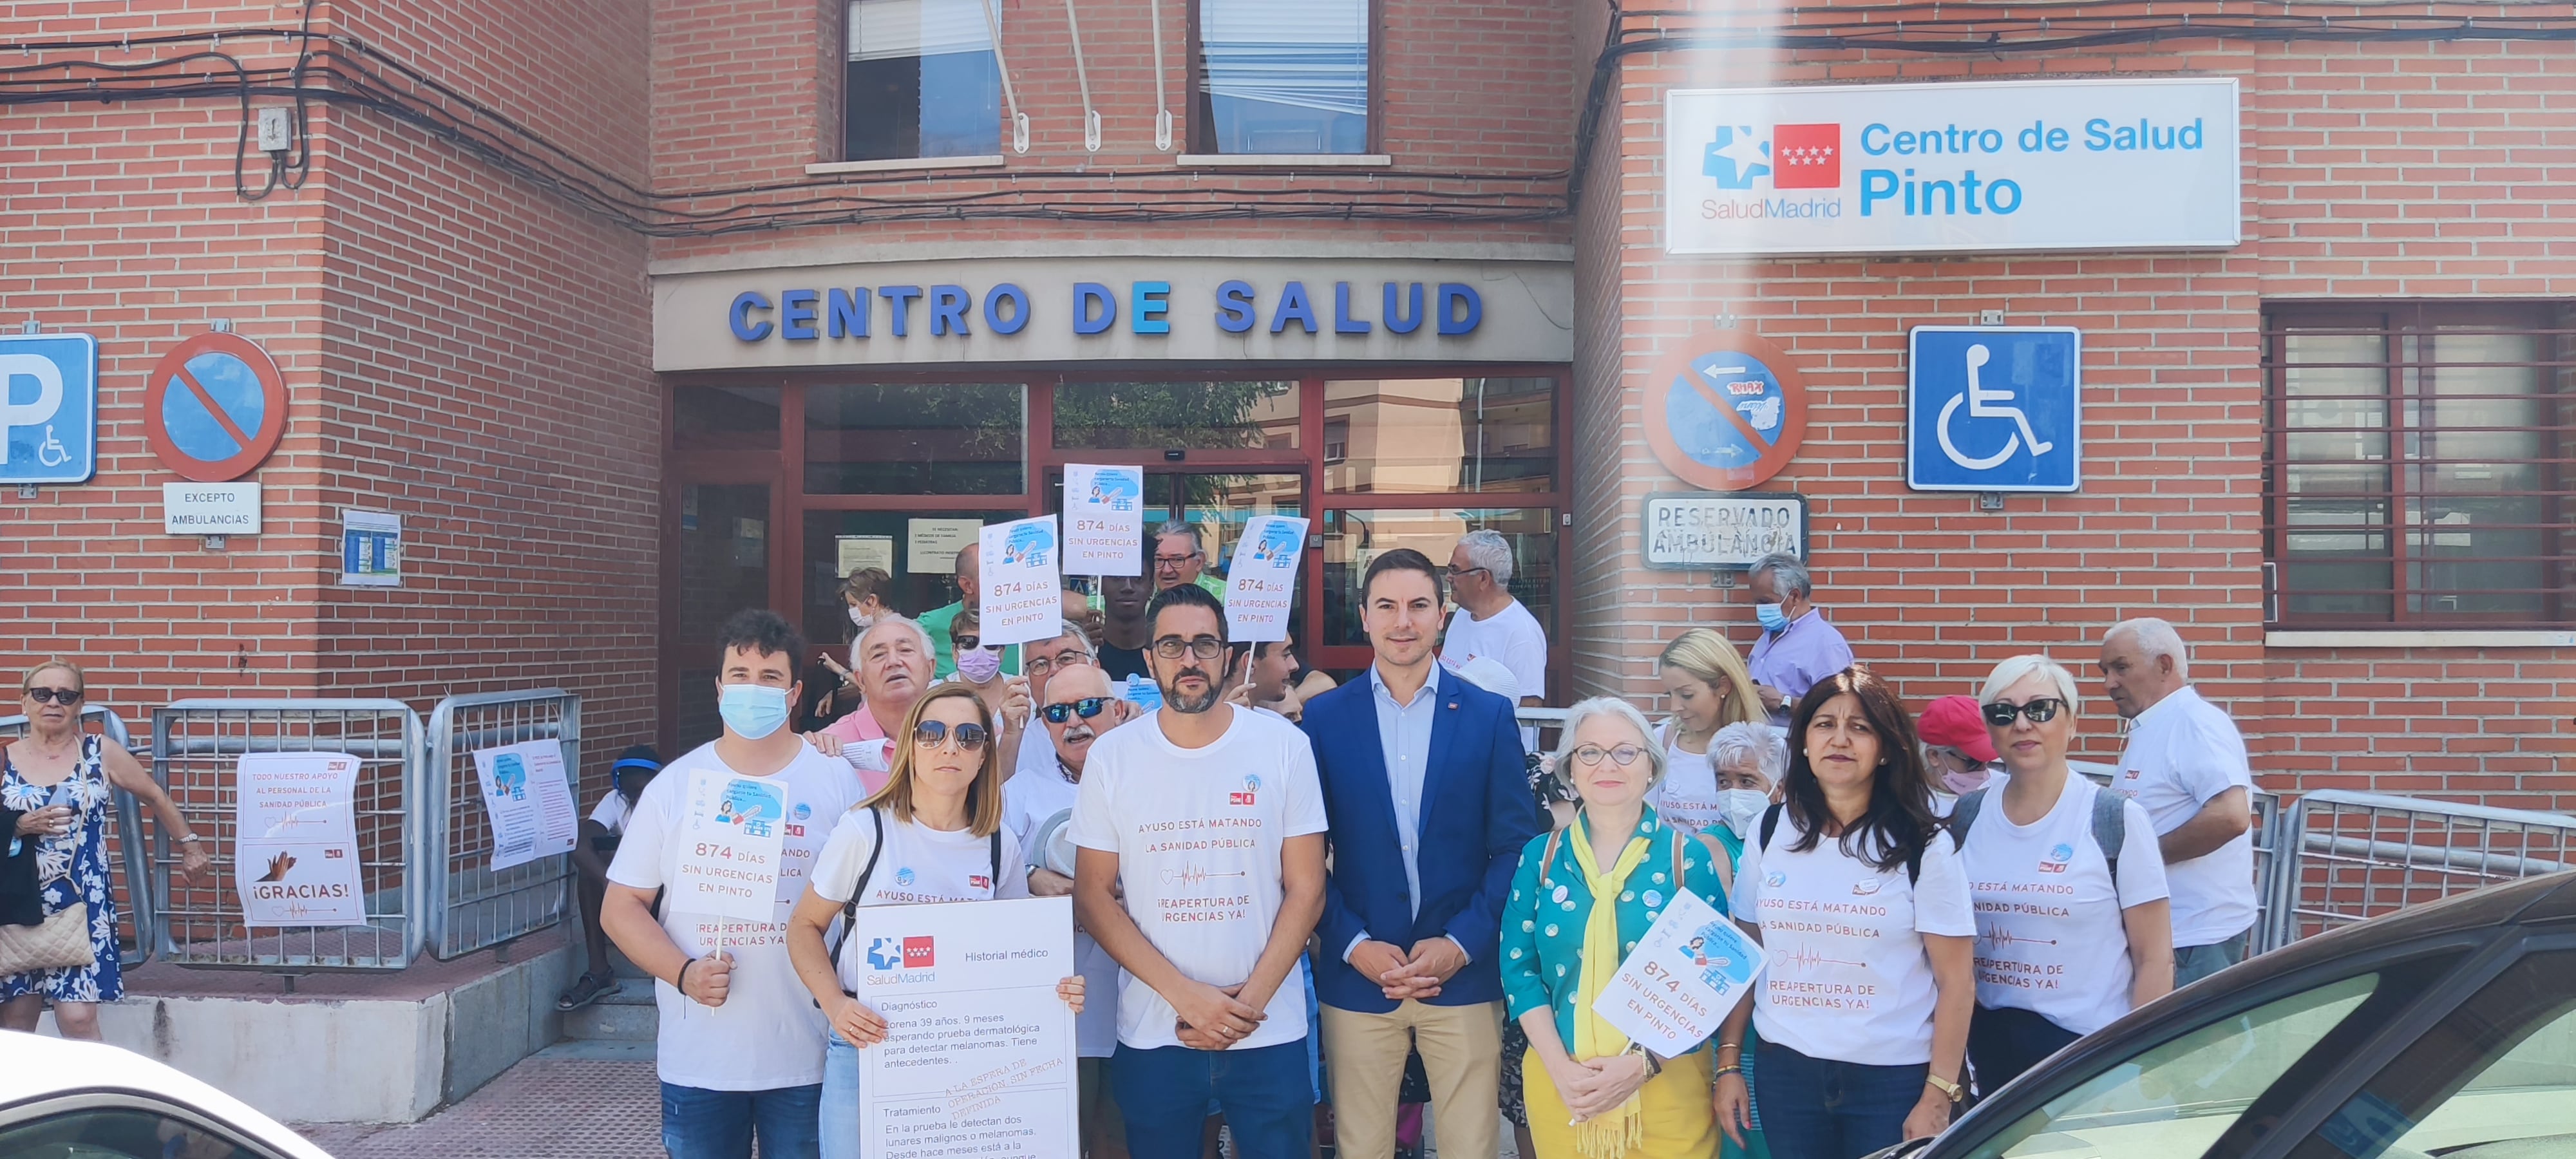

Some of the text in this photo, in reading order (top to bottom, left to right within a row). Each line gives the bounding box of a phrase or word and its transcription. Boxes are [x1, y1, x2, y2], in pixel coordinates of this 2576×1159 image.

[1861, 117, 2202, 156] Centro de Salud
[1860, 168, 2022, 216] Pinto
[1701, 197, 1841, 220] SaludMadrid
[729, 279, 1482, 341] CENTRO DE SALUD
[185, 493, 235, 502] EXCEPTO
[172, 514, 249, 525] AMBULANCIAS
[1658, 507, 1790, 528] RESERVADO
[1077, 520, 1130, 532] 874 DÍAS
[1087, 538, 1138, 547] URGENCIAS
[1653, 531, 1796, 555] AMBULANCIA
[994, 581, 1048, 597] 874 DÍAS
[1238, 579, 1283, 592] 874 DÍAS
[985, 596, 1057, 614] SIN URGENCIAS
[1228, 599, 1287, 608] SIN URGENCIAS
[1001, 612, 1043, 626] EN PINTO
[294, 799, 327, 807] PÚBLICA
[1683, 802, 1707, 810] ESTÁ
[1138, 818, 1262, 834] AYUSO ESTÁ MATANDO
[696, 842, 765, 863] 874 DÍAS
[1145, 837, 1255, 853] LA SANIDAD PÚBLICA
[781, 849, 810, 858] ANDO
[682, 864, 773, 884] SIN URGENCIAS
[780, 868, 802, 877] LICA
[253, 884, 348, 900] ¡GRACIAS!
[699, 883, 752, 898] EN PINTO
[876, 889, 914, 901] AYUSO
[1978, 881, 2007, 892] ESTÁ
[2011, 883, 2074, 895] MATANDO
[1158, 895, 1249, 909] ¡REAPERTURA DE
[1788, 900, 1818, 912] ESTÁ
[1823, 903, 1886, 916] MATANDO
[1974, 902, 2069, 917] NIDAD PÚBLICA
[1161, 909, 1245, 922] URGENCIAS YA!
[780, 922, 787, 931] D
[1770, 921, 1822, 933] SANIDAD
[1826, 923, 1880, 938] PÚBLICA
[965, 948, 1048, 962] Historial médico
[2047, 965, 2063, 975] DE
[867, 971, 935, 986] SaludMadrid
[2035, 979, 2058, 989] YA!
[1644, 960, 1707, 1017] 874 DÍAS
[1766, 980, 1875, 995] ¡REAPERTURA DE
[881, 999, 938, 1012] Diagnóstico
[1622, 972, 1703, 1039] SIN URGENCIAS
[1772, 995, 1870, 1009] URGENCIAS YA!
[920, 1017, 932, 1026] 39
[935, 1016, 961, 1026] años.
[964, 1015, 970, 1024] 9
[972, 1014, 1004, 1023] meses
[1627, 999, 1676, 1039] EN PINTO
[884, 1024, 1040, 1043] esperando prueba dermatológica
[884, 1037, 1037, 1057] para detectar melanomas. Tiene
[884, 1058, 952, 1069] antecedentes.
[1010, 1071, 1028, 1084] SIN
[1028, 1057, 1063, 1075] FECHA
[945, 1059, 1027, 1097] A LA ESPERA DE
[883, 1105, 941, 1118] Tratamiento
[951, 1095, 1001, 1120] DEFINIDA
[886, 1116, 1021, 1134] En la prueba le detectan dos
[886, 1137, 921, 1147] lunares
[924, 1133, 967, 1144] malignos
[979, 1127, 1036, 1139] melanomas.
[886, 1149, 918, 1159] Desde
[920, 1147, 943, 1157] hace
[947, 1145, 978, 1155] meses
[981, 1141, 1001, 1152] está
[1013, 1141, 1021, 1149] la
